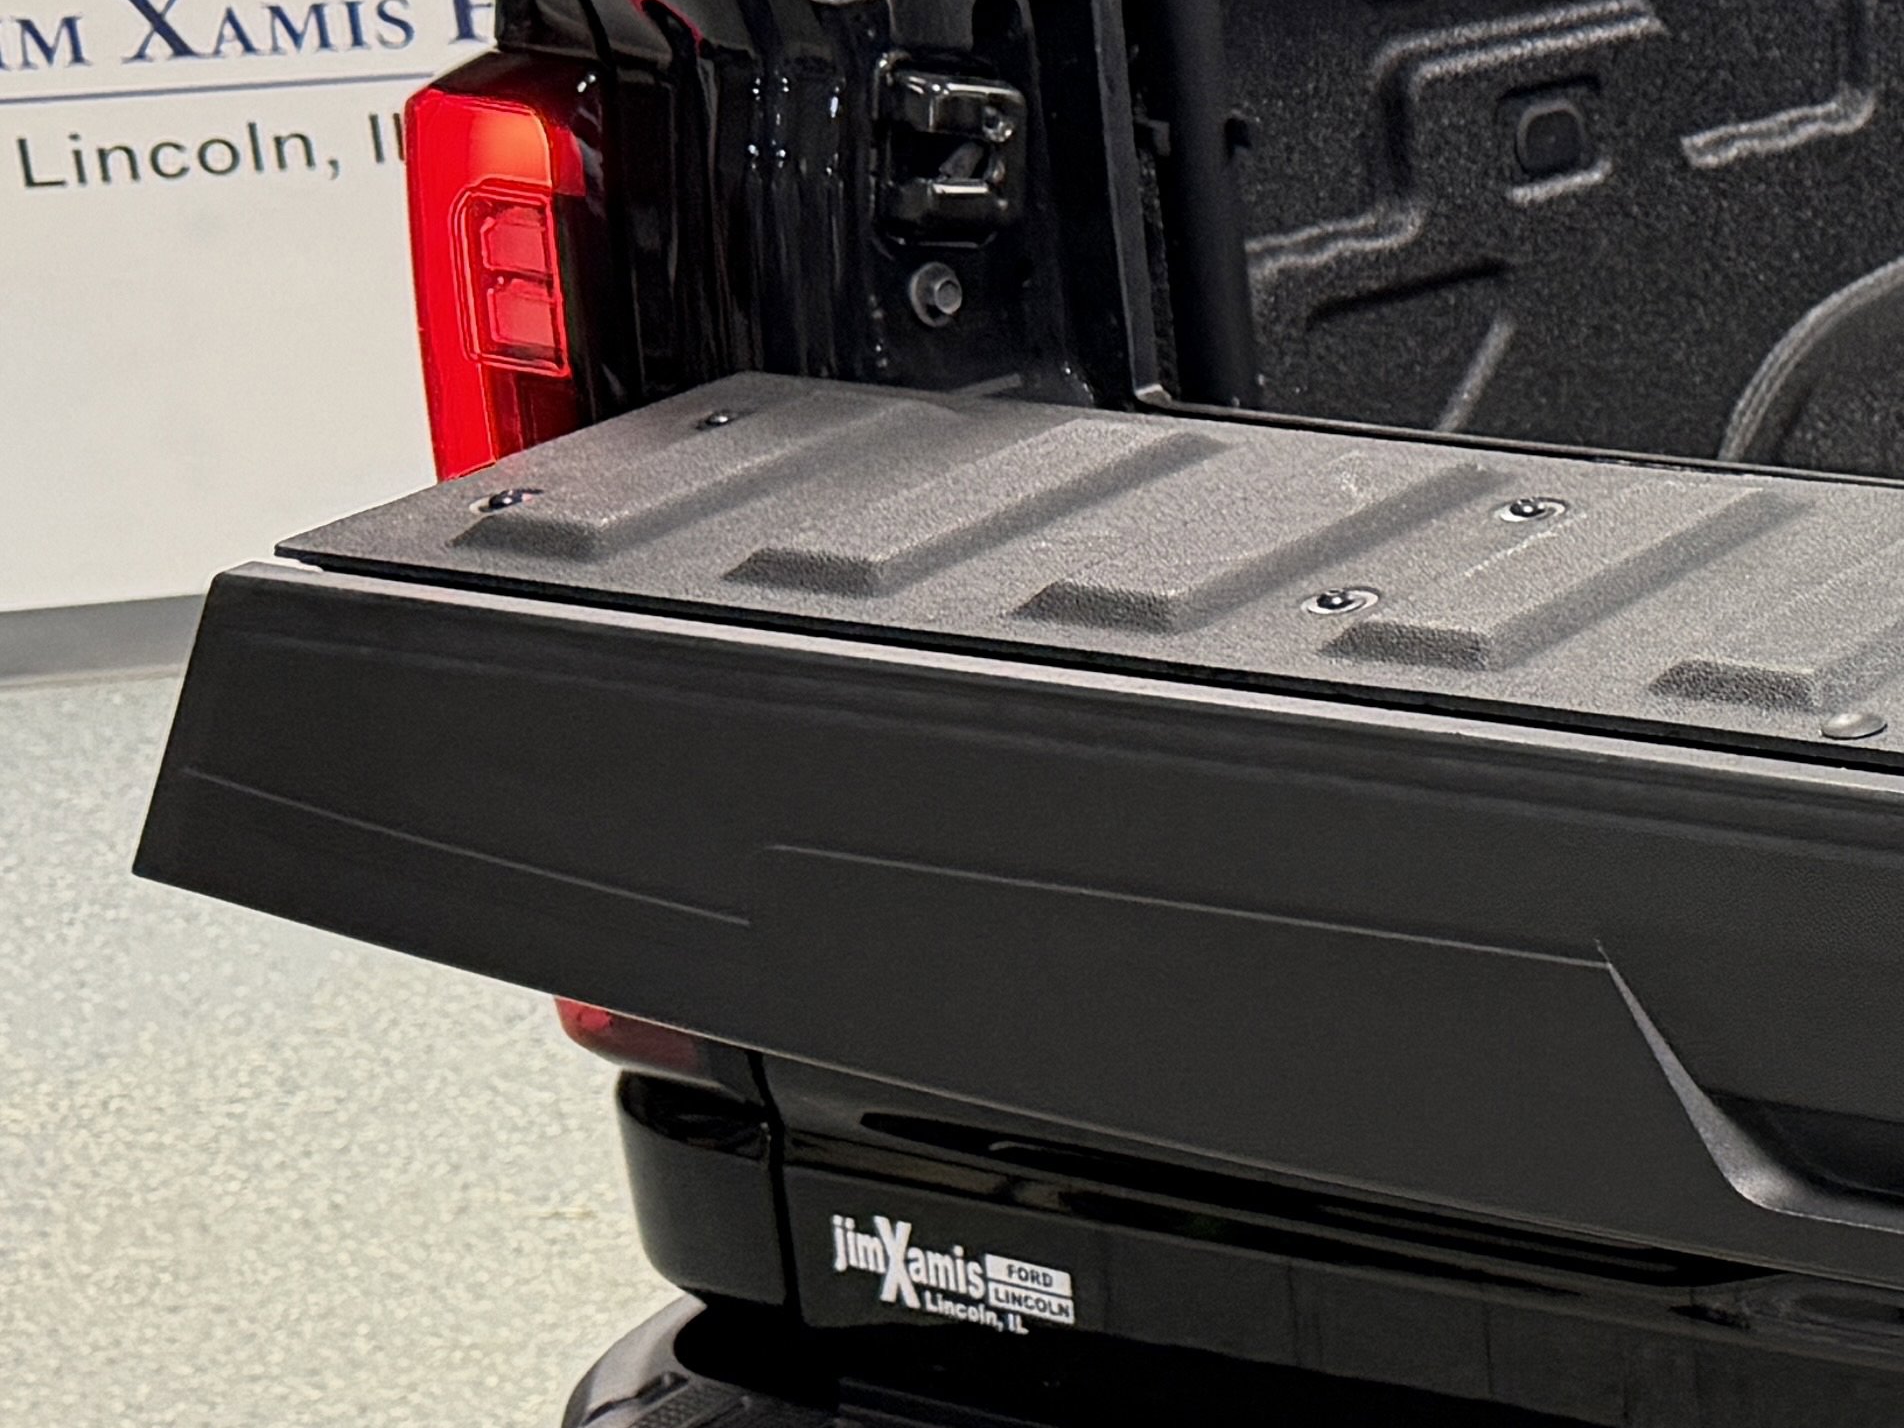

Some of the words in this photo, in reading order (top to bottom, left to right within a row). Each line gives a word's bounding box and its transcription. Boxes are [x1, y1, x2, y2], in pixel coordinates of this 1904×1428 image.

[17, 121, 340, 188] Lincoln,
[1007, 1263, 1053, 1288] FORD
[922, 1290, 1003, 1332] Lincoln,
[1009, 1313, 1029, 1335] IL
[994, 1289, 1070, 1318] LINCOLN
